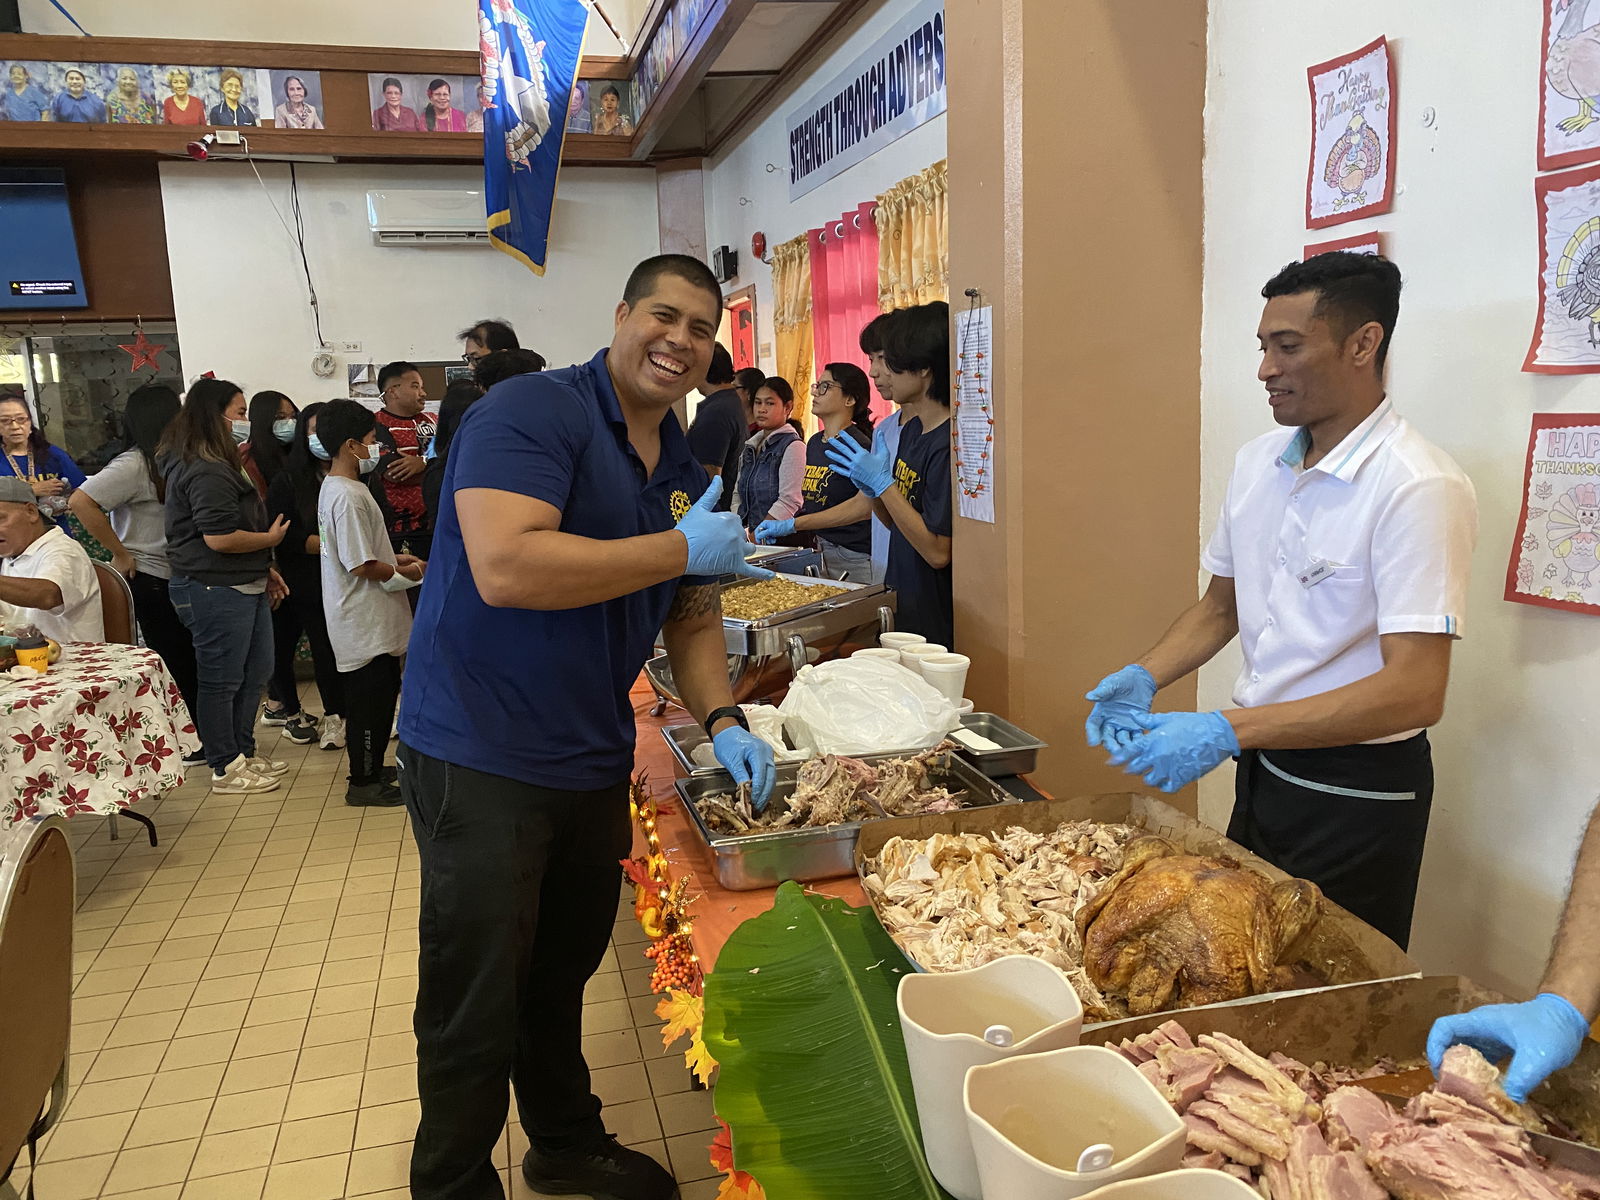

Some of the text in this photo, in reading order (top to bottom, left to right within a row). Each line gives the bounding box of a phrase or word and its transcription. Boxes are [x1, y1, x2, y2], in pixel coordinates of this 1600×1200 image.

[790, 9, 946, 184] STRENGTH THROUGH ADVERS
[1338, 68, 1371, 94] Happy
